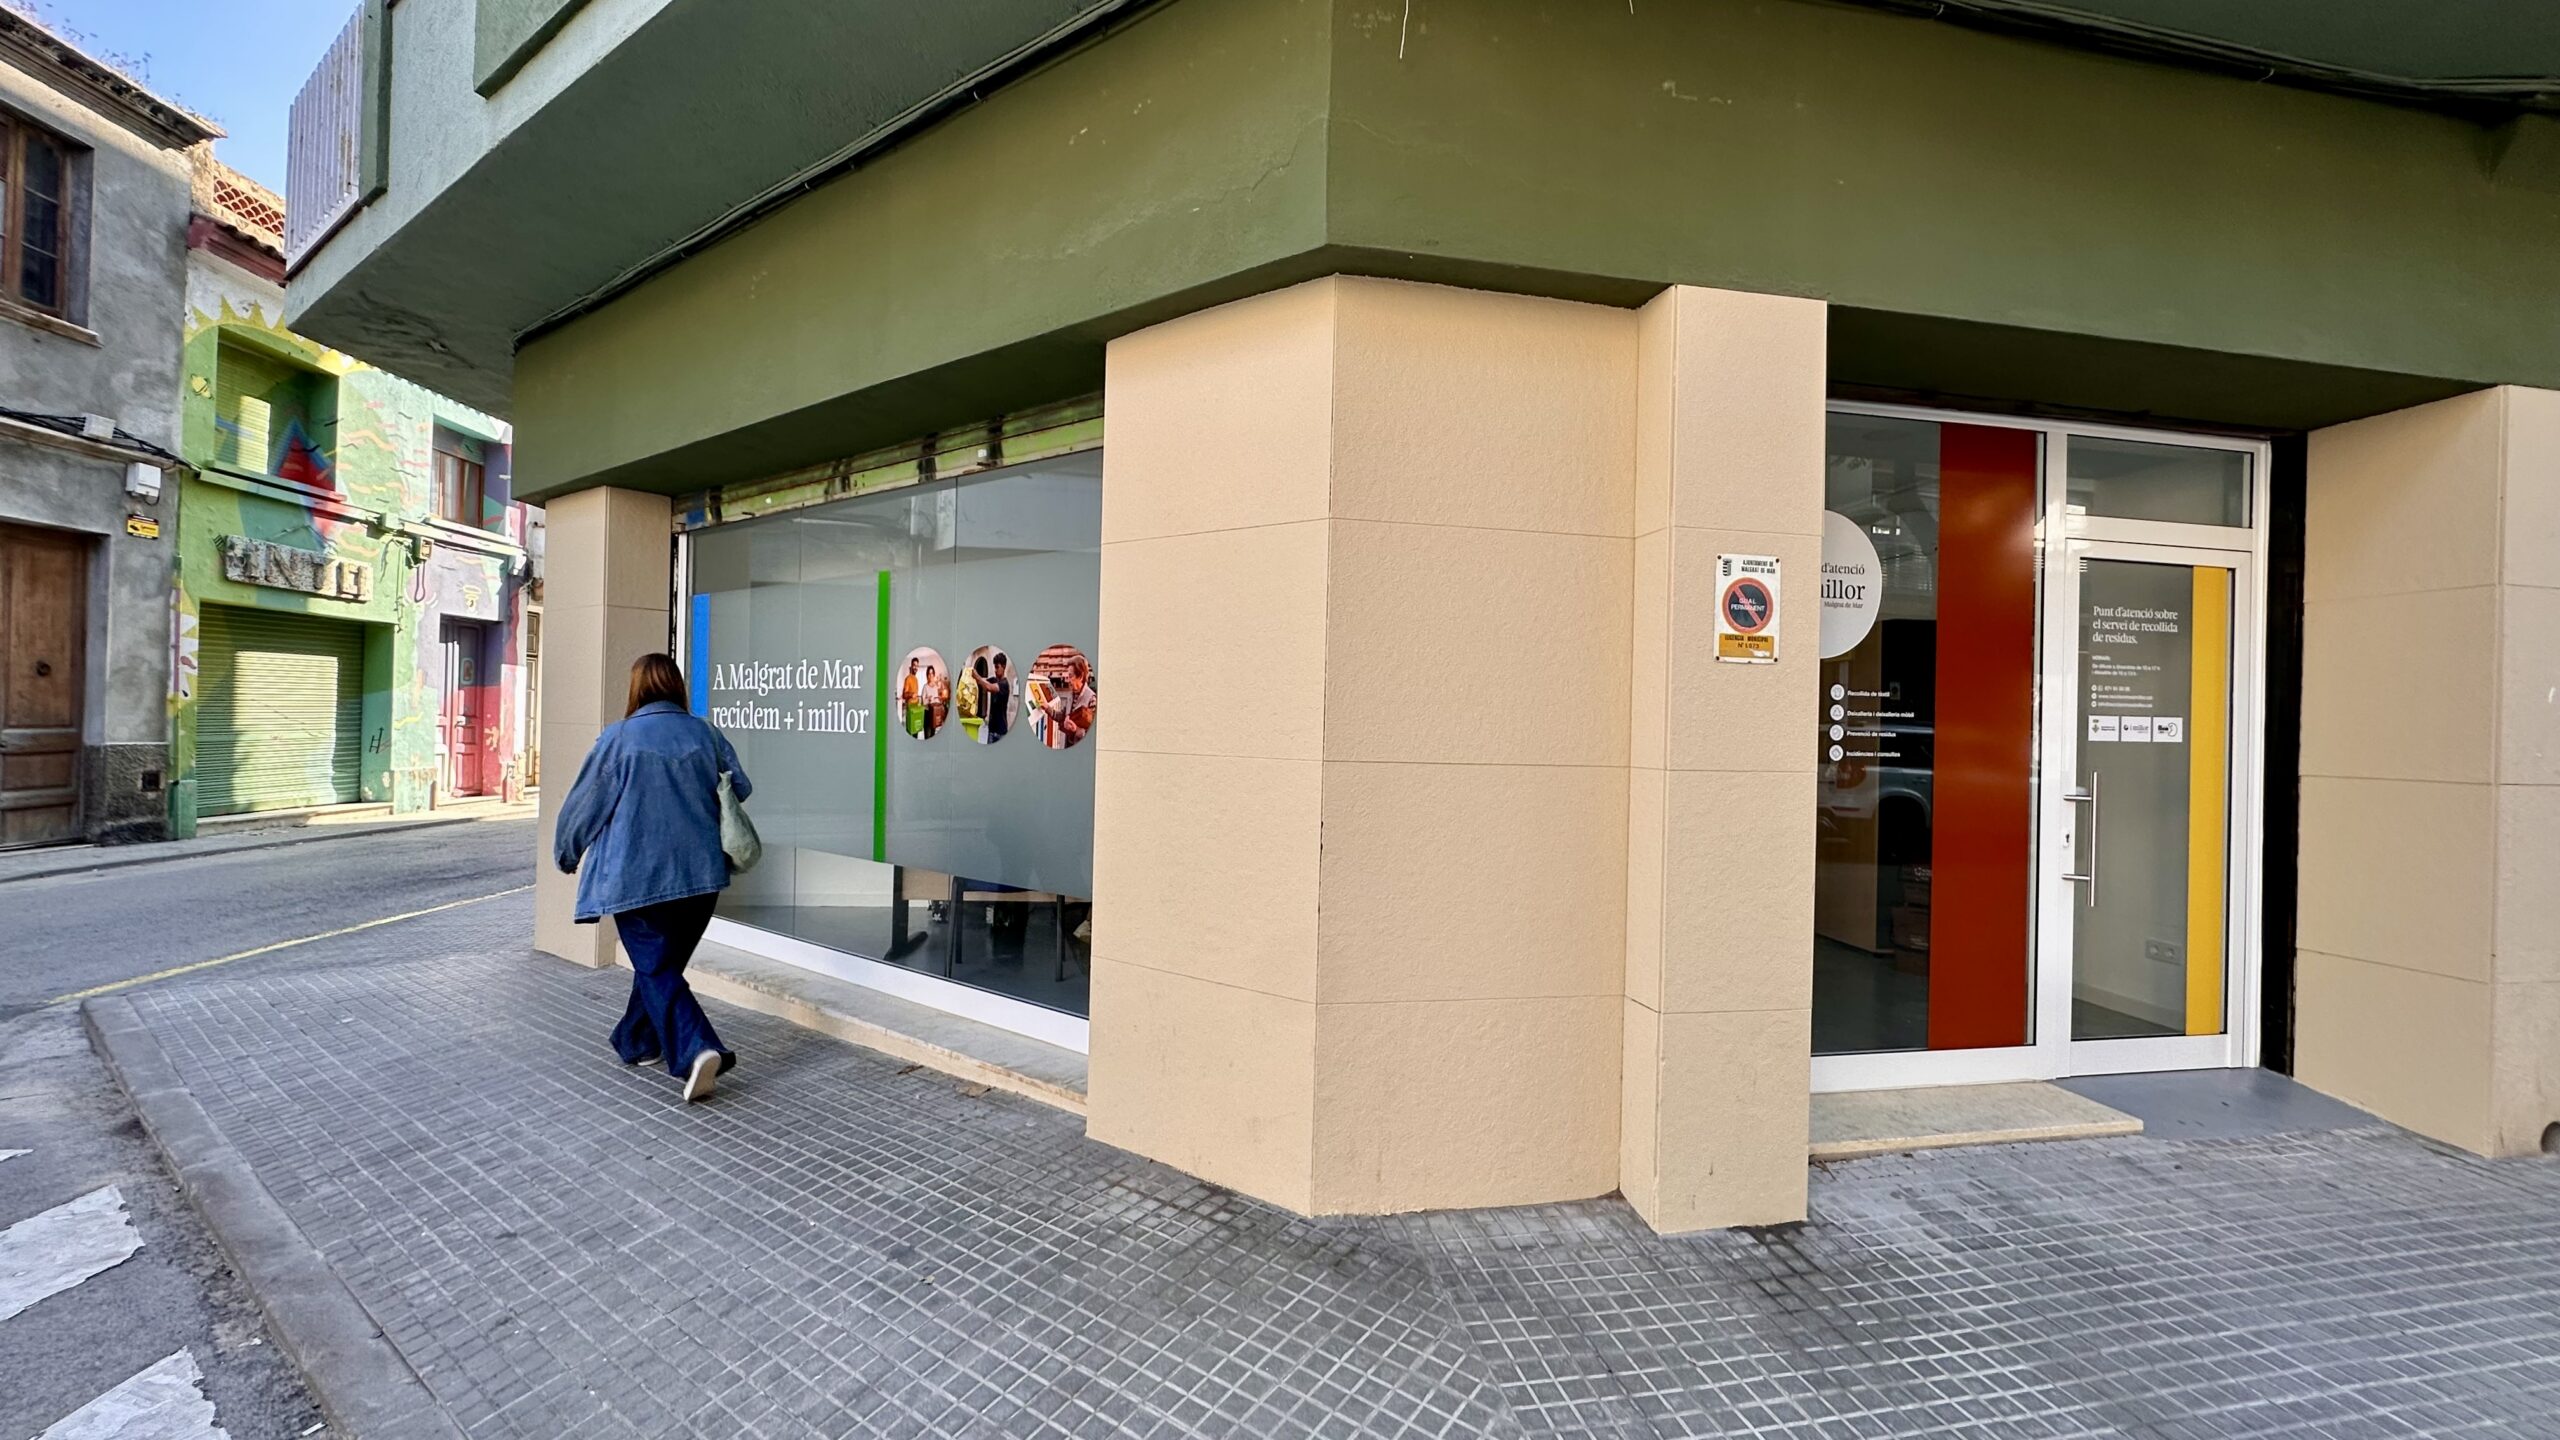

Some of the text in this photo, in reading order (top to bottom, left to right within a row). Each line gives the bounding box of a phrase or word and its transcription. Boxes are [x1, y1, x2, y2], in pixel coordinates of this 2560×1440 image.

[1821, 562, 1865, 575] d'atenció
[2093, 606, 2178, 620] Punt d'atenció sobre
[2092, 618, 2178, 633] el servei de recollida
[2092, 631, 2104, 642] de
[712, 659, 863, 696] A Malgrat de Mar
[712, 701, 869, 734] reciclem + i millor
